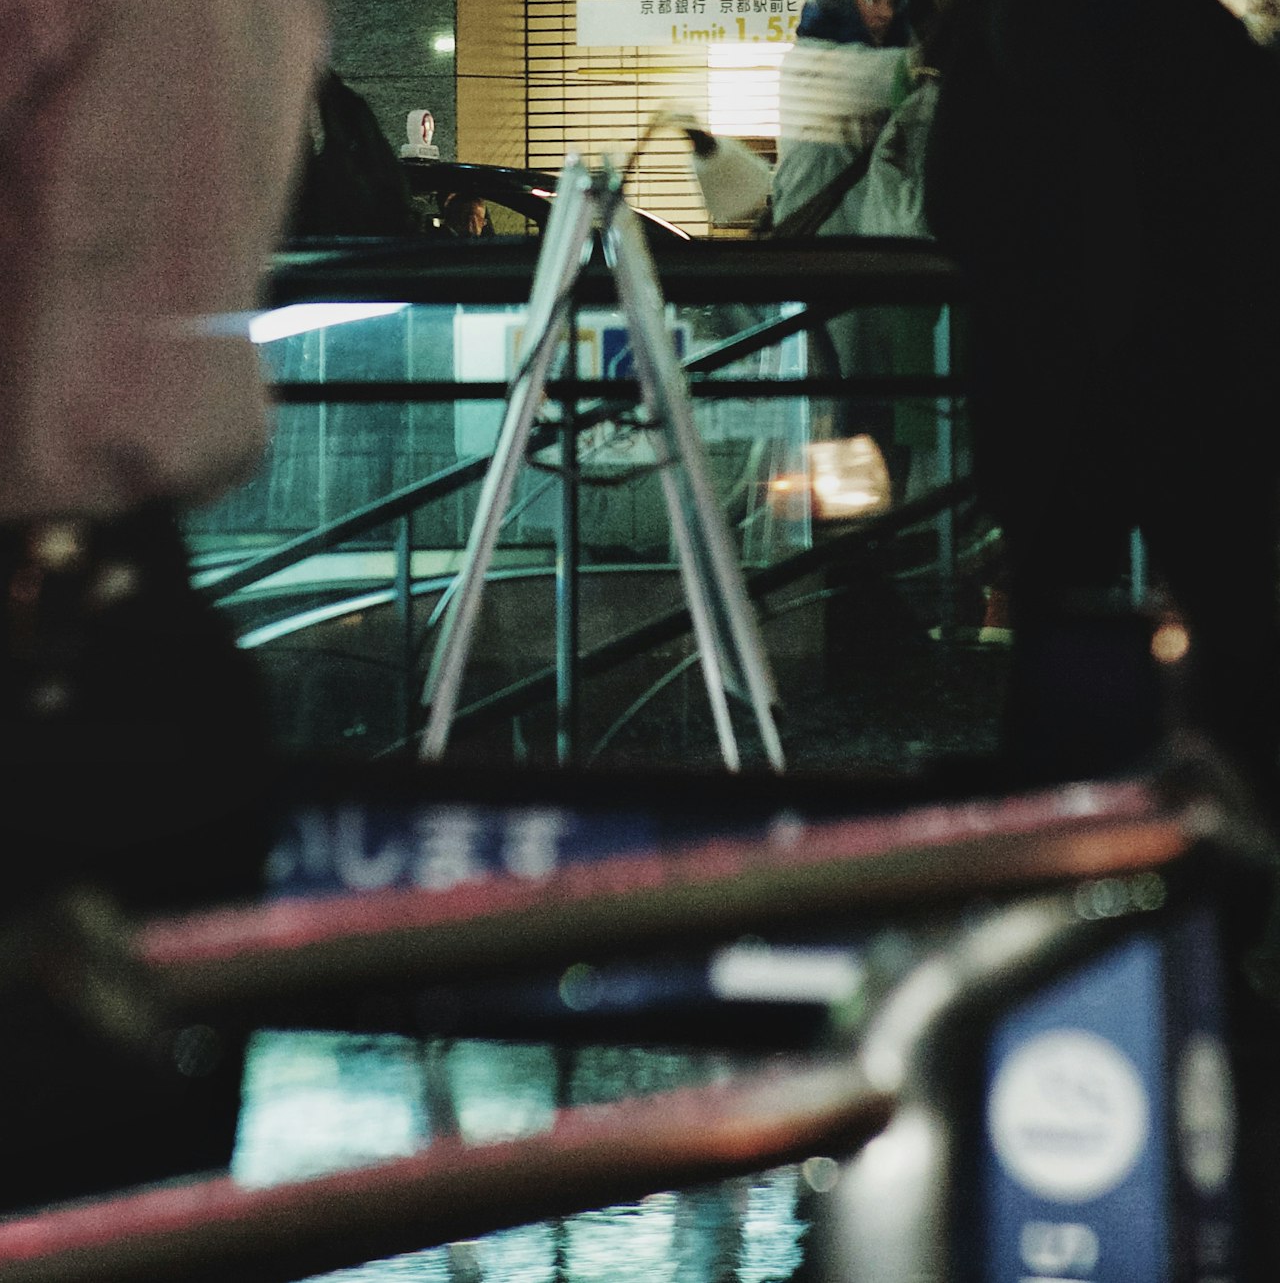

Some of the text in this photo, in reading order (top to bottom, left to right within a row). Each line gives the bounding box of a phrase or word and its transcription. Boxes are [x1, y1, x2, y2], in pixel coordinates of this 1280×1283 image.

[640, 0, 706, 16] 京都銀行
[671, 22, 727, 45] Limit
